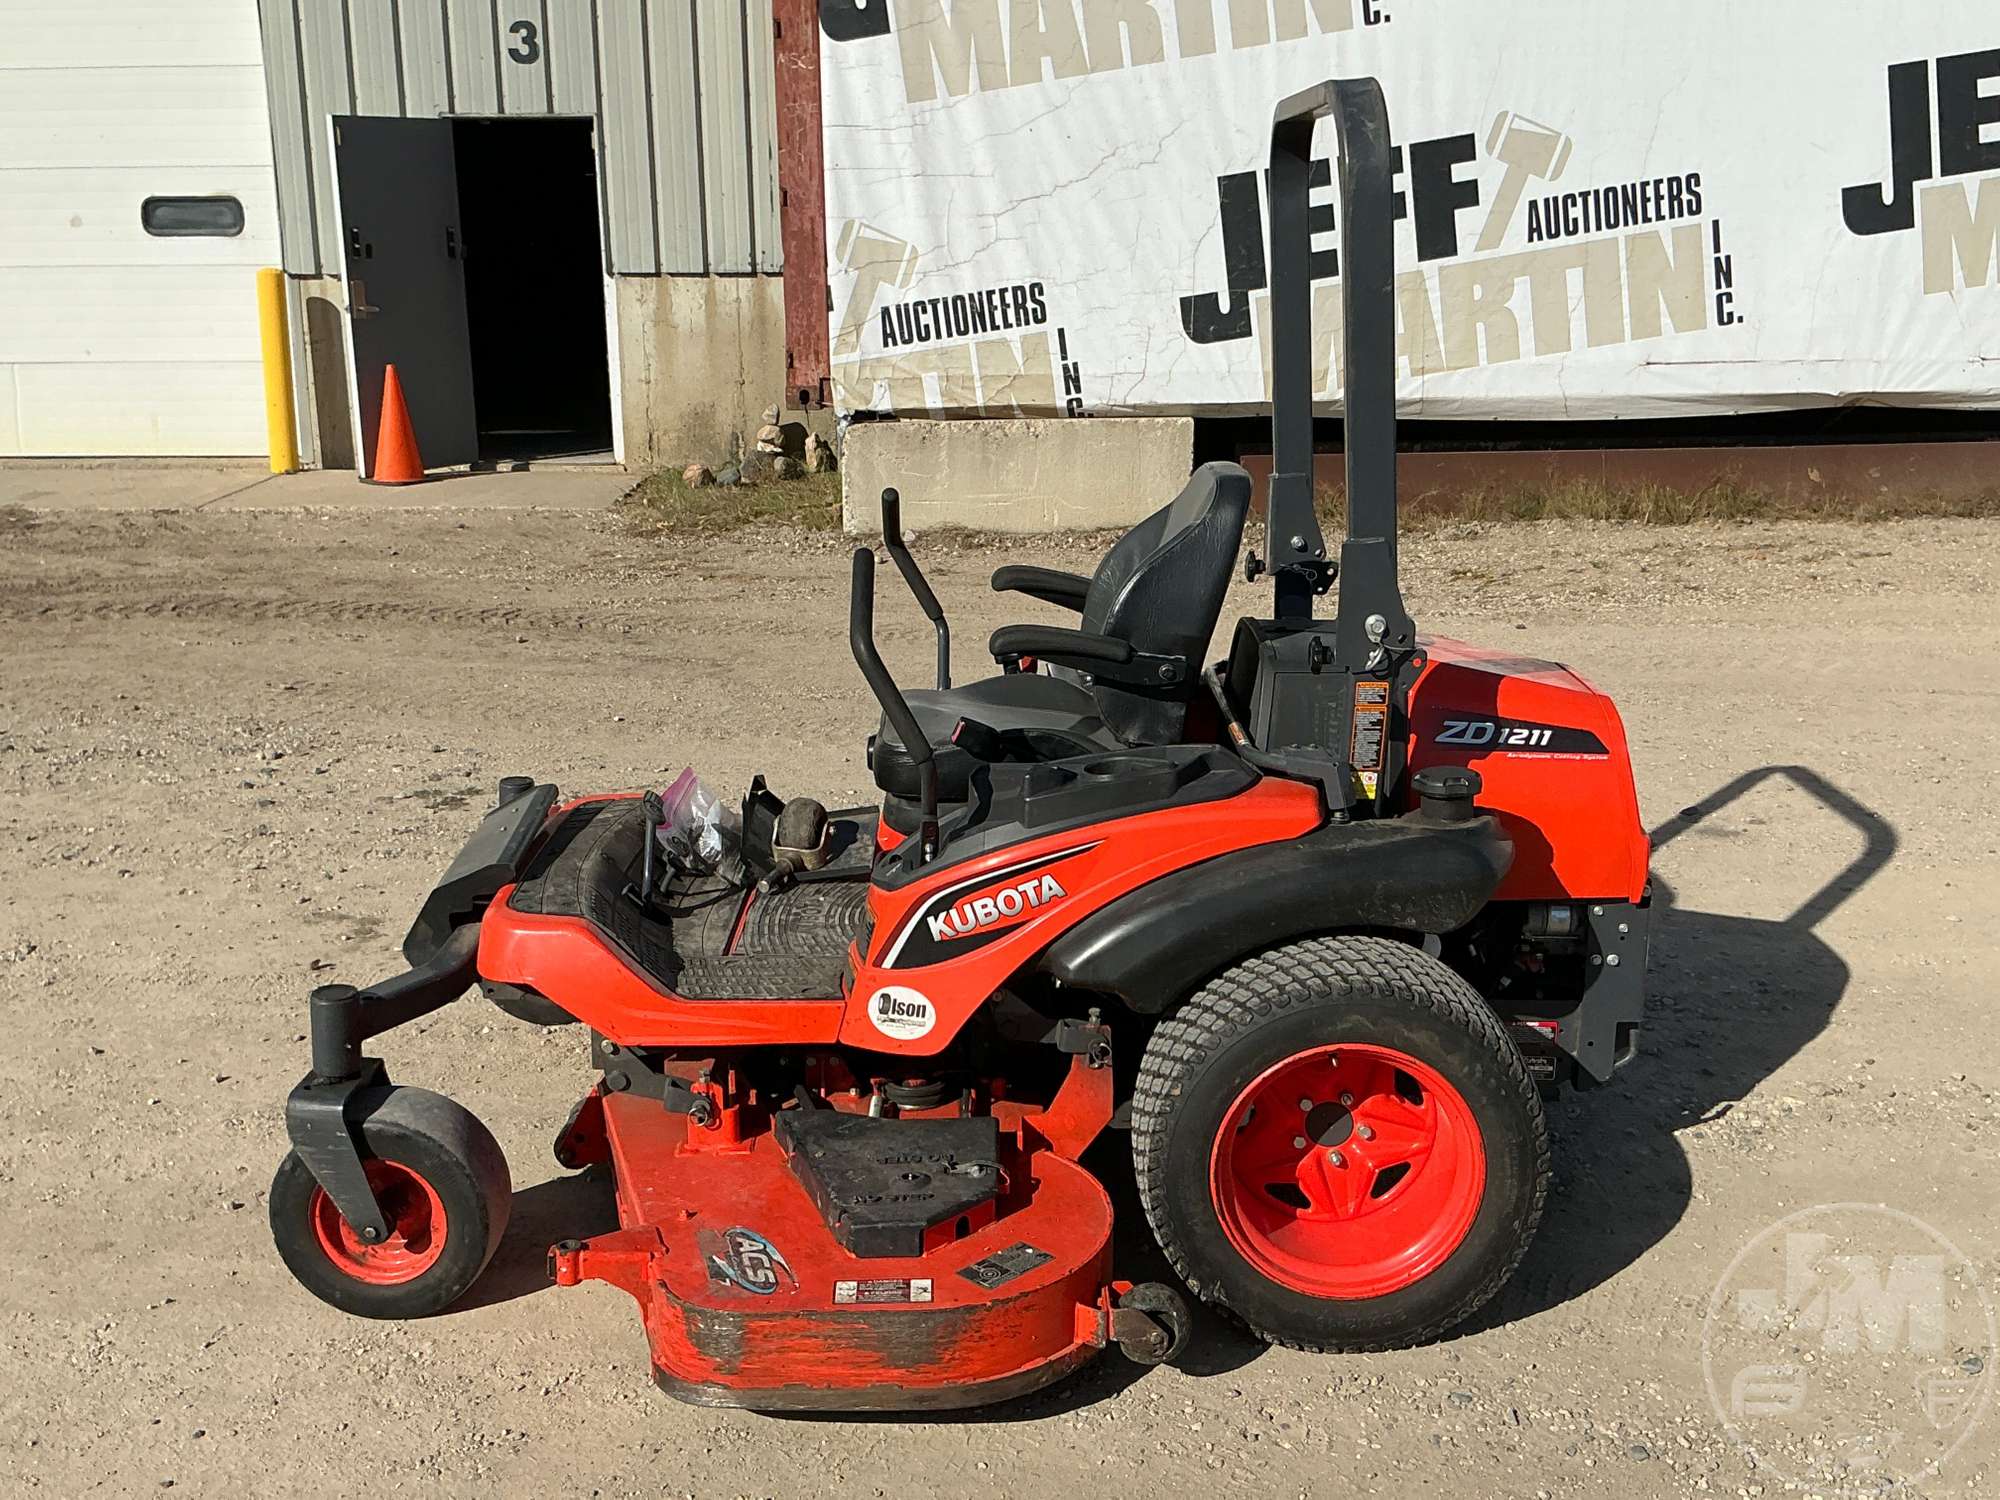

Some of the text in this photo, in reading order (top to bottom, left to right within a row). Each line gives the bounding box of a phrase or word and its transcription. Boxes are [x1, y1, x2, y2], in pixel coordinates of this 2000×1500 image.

[508, 20, 540, 65] 3
[1179, 132, 1480, 345] JEF
[1526, 171, 1703, 244] AUCTIONEERS
[1712, 219, 1744, 326] INC.
[880, 281, 1048, 349] AUCTIONEERS
[1434, 720, 1553, 746] ZD 1211
[927, 874, 1067, 942] KUBOTA
[878, 992, 927, 1019] Olson
[735, 1236, 777, 1284] ACS
